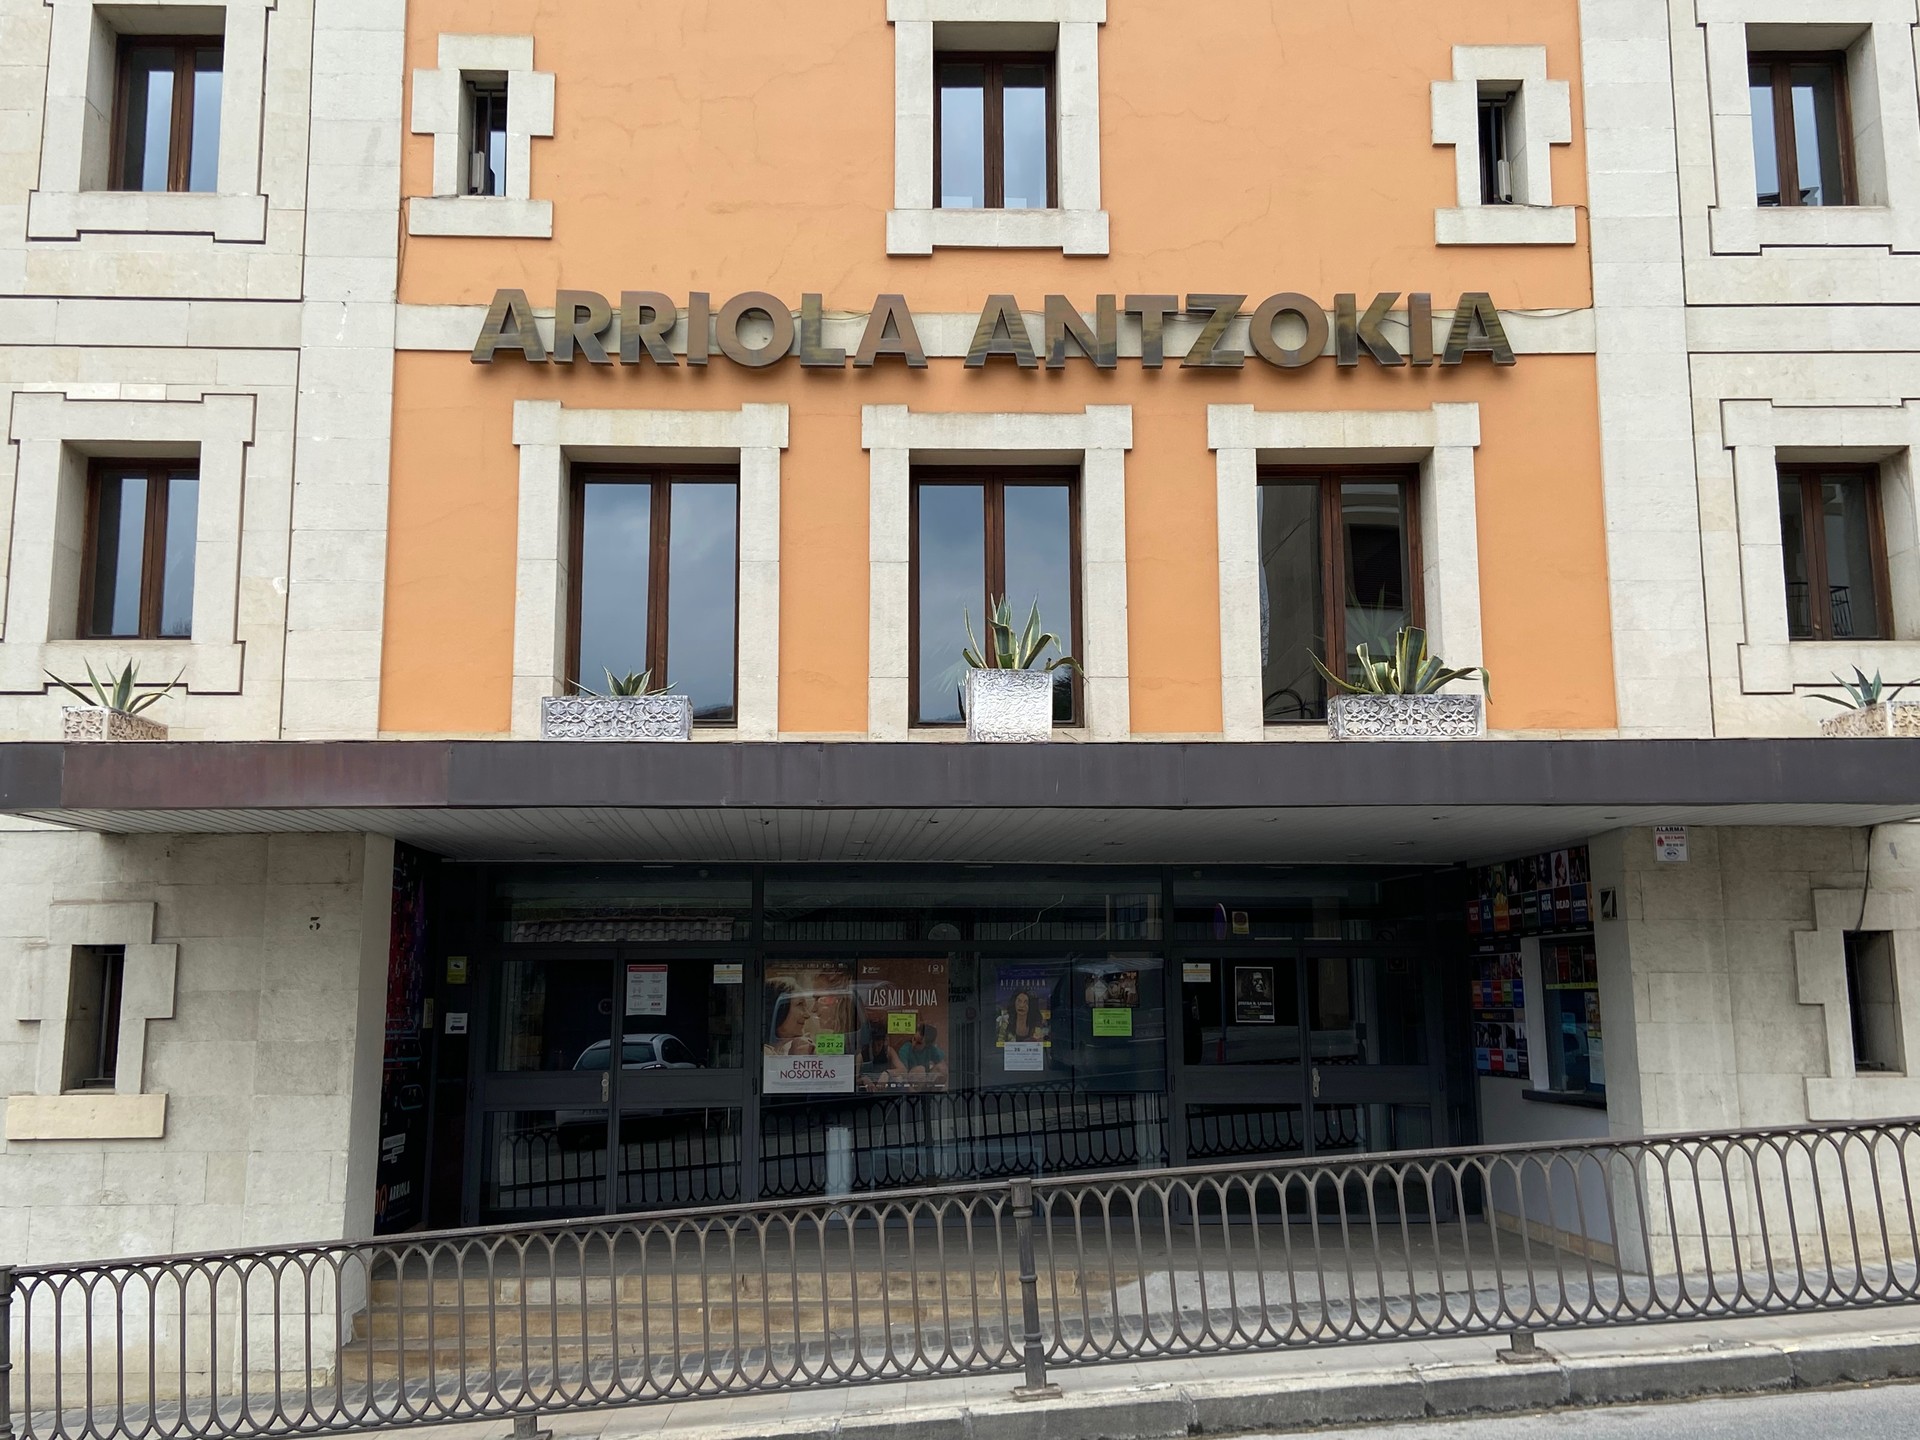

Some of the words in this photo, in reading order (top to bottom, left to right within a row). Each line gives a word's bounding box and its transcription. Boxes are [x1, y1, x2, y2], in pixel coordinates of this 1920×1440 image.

[470, 288, 928, 369] ARRIOLA
[963, 291, 1517, 370] ANTZOKIA
[868, 989, 886, 1006] LAS
[888, 989, 907, 1006] MIL
[907, 989, 914, 1006] Y
[916, 989, 938, 1006] UNA
[793, 1060, 824, 1070] ENTRE
[780, 1069, 836, 1079] NOSOTRAS
